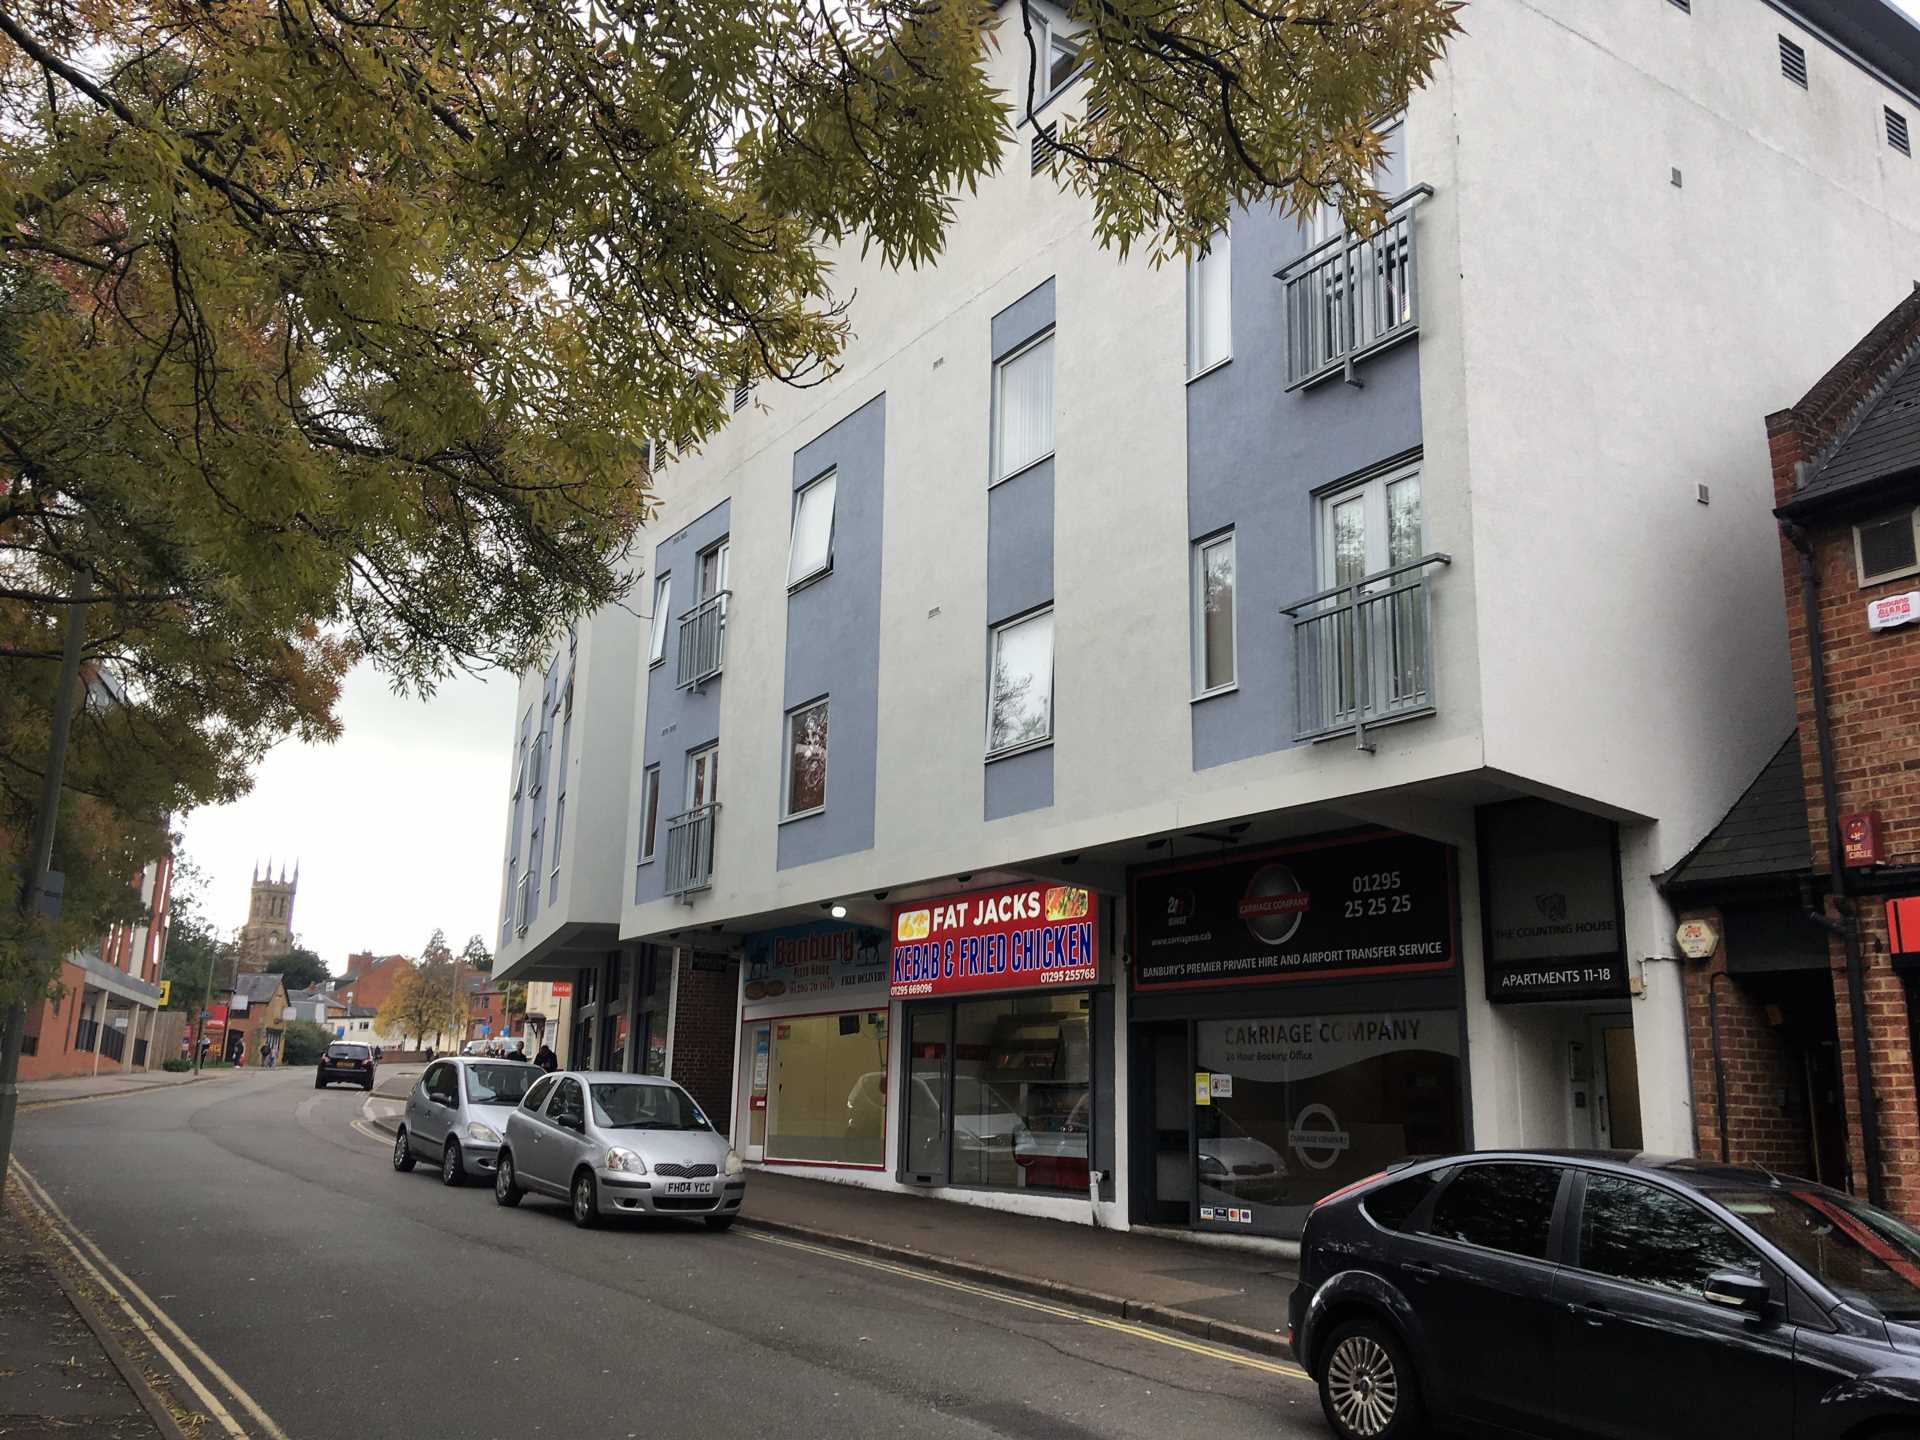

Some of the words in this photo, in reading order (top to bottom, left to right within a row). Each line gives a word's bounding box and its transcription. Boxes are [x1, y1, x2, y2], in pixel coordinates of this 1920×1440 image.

[1846, 843, 1863, 852] BLUE
[1849, 849, 1873, 859] CIRCLE
[1352, 870, 1401, 894] 01295
[933, 902, 968, 932] FAT
[973, 891, 1041, 926] JACKS
[1344, 899, 1364, 919] 25
[1368, 897, 1387, 916] 25
[1391, 894, 1412, 913] 25
[1516, 924, 1573, 938] COUNTING
[1575, 920, 1616, 933] HOUSE
[775, 928, 855, 967] Banbury
[893, 941, 940, 983] KEBAB
[944, 938, 955, 978] &
[959, 933, 1007, 976] FRIED
[1011, 921, 1093, 972] CHICKEN
[1143, 962, 1186, 978] BANBURY'S
[1186, 960, 1222, 975] PREMIER
[1223, 957, 1257, 972] PRIVATE
[1258, 955, 1279, 968] HIRE
[1280, 952, 1301, 967] AND
[1302, 949, 1344, 964] AIRPORT
[1345, 945, 1398, 961] TRANSFER
[1398, 941, 1443, 957] SERVICE
[1040, 970, 1064, 984] 01295
[1065, 967, 1096, 982] 255768
[1502, 969, 1581, 987] APARTMENTS
[1584, 967, 1612, 982] 11-18
[890, 985, 908, 997] 01295
[908, 983, 933, 995] 669096
[1225, 1023, 1313, 1046] CARRIAGE
[1319, 1018, 1422, 1042] COMPANY
[668, 1183, 691, 1193] FH04
[694, 1183, 711, 1193] YCC
